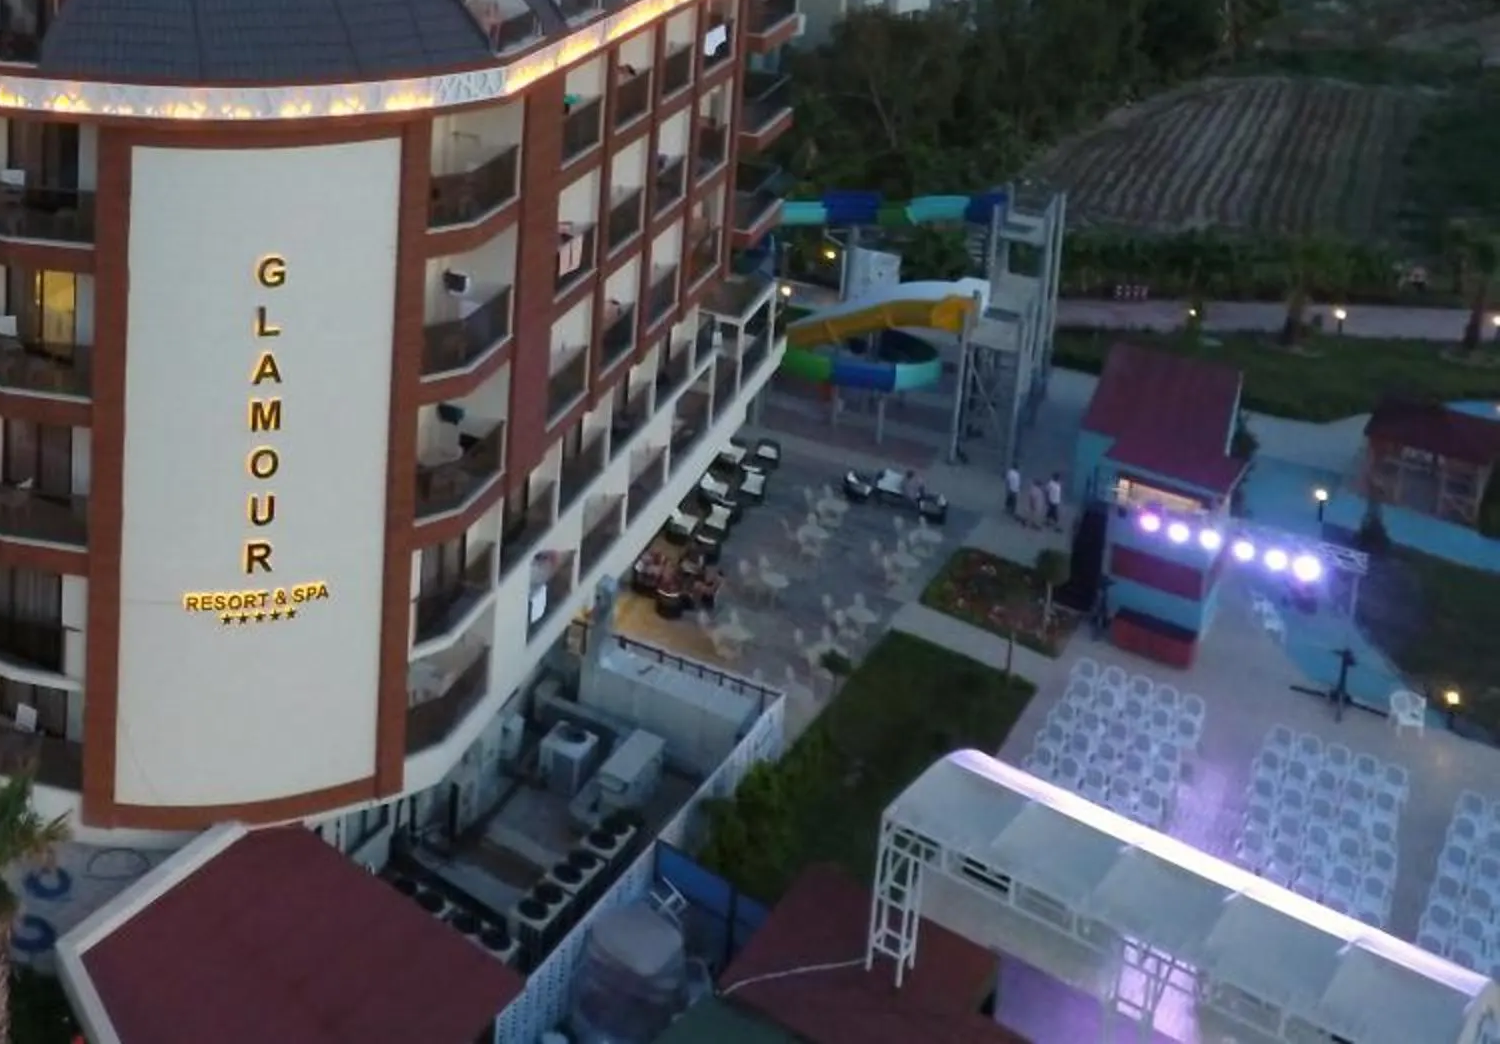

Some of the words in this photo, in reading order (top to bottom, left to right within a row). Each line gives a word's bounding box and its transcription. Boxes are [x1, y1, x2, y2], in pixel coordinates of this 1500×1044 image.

[244, 256, 287, 574] GLAMOUR
[185, 592, 269, 612] RESORT
[274, 588, 287, 605] &
[293, 583, 329, 604] SPA
